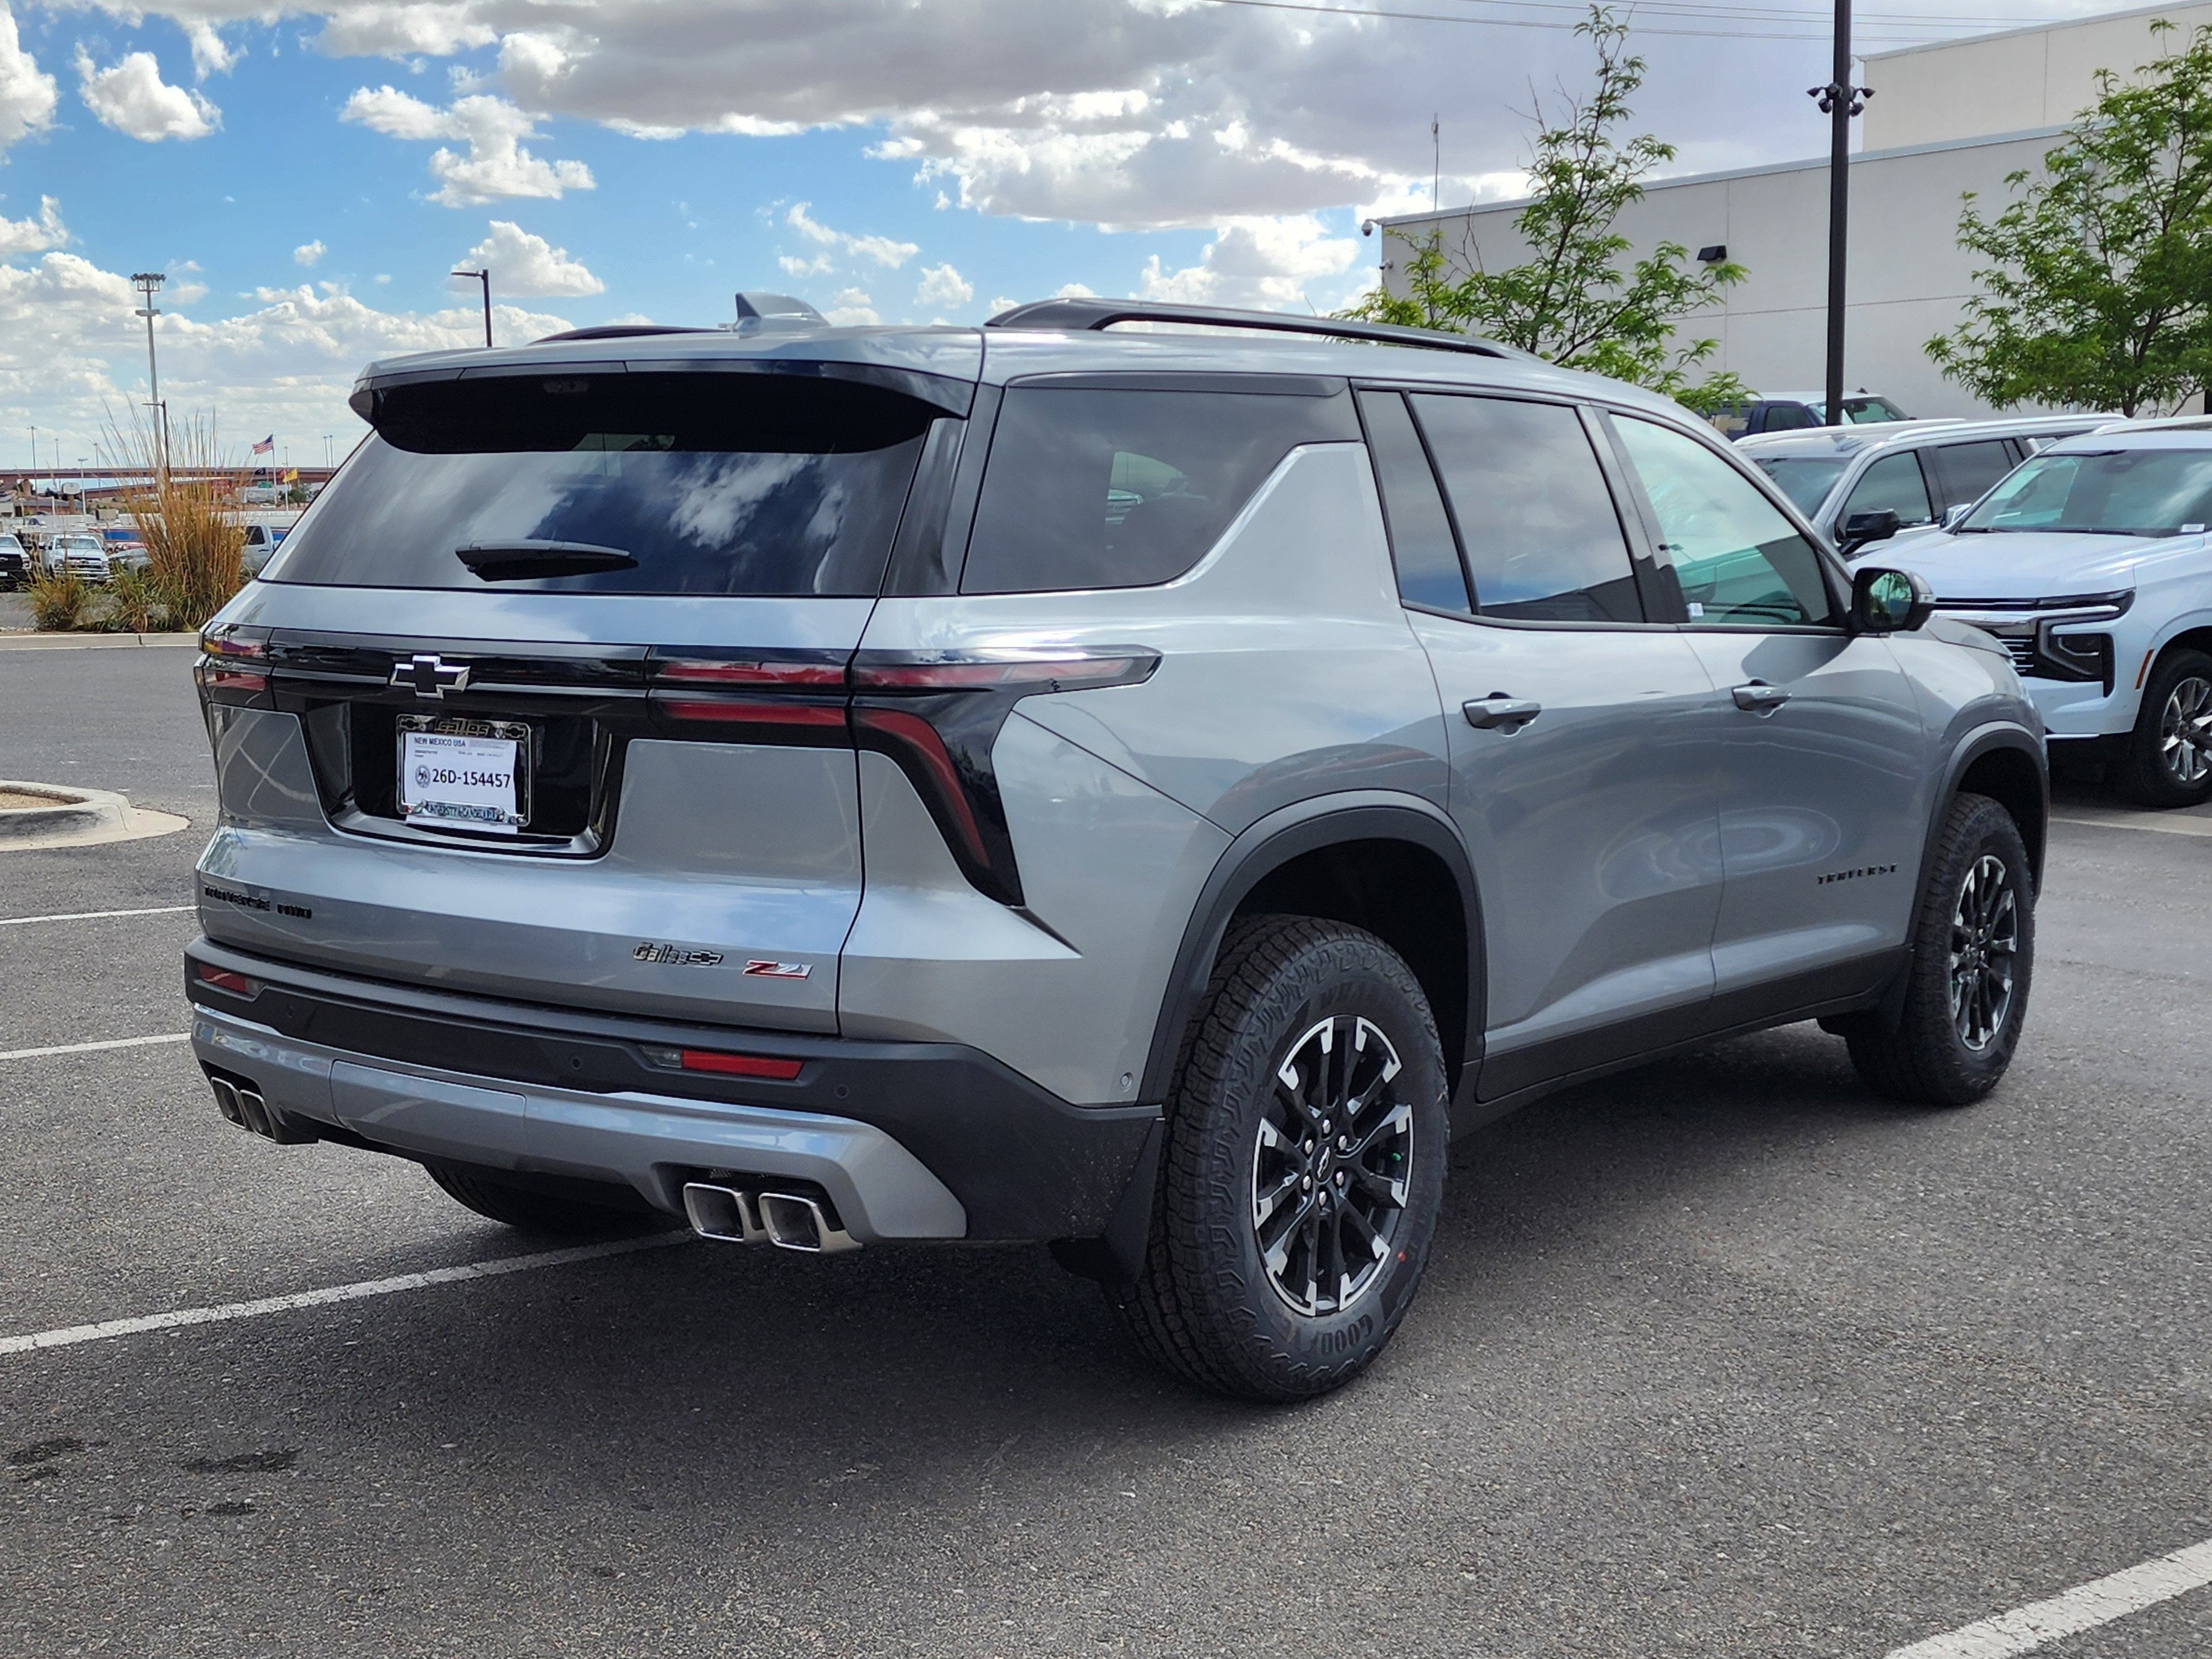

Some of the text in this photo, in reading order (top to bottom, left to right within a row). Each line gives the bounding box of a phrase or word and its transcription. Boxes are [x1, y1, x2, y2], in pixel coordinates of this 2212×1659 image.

[415, 737, 466, 748] NEW MEXICO USA
[432, 768, 510, 789] 26D-154457
